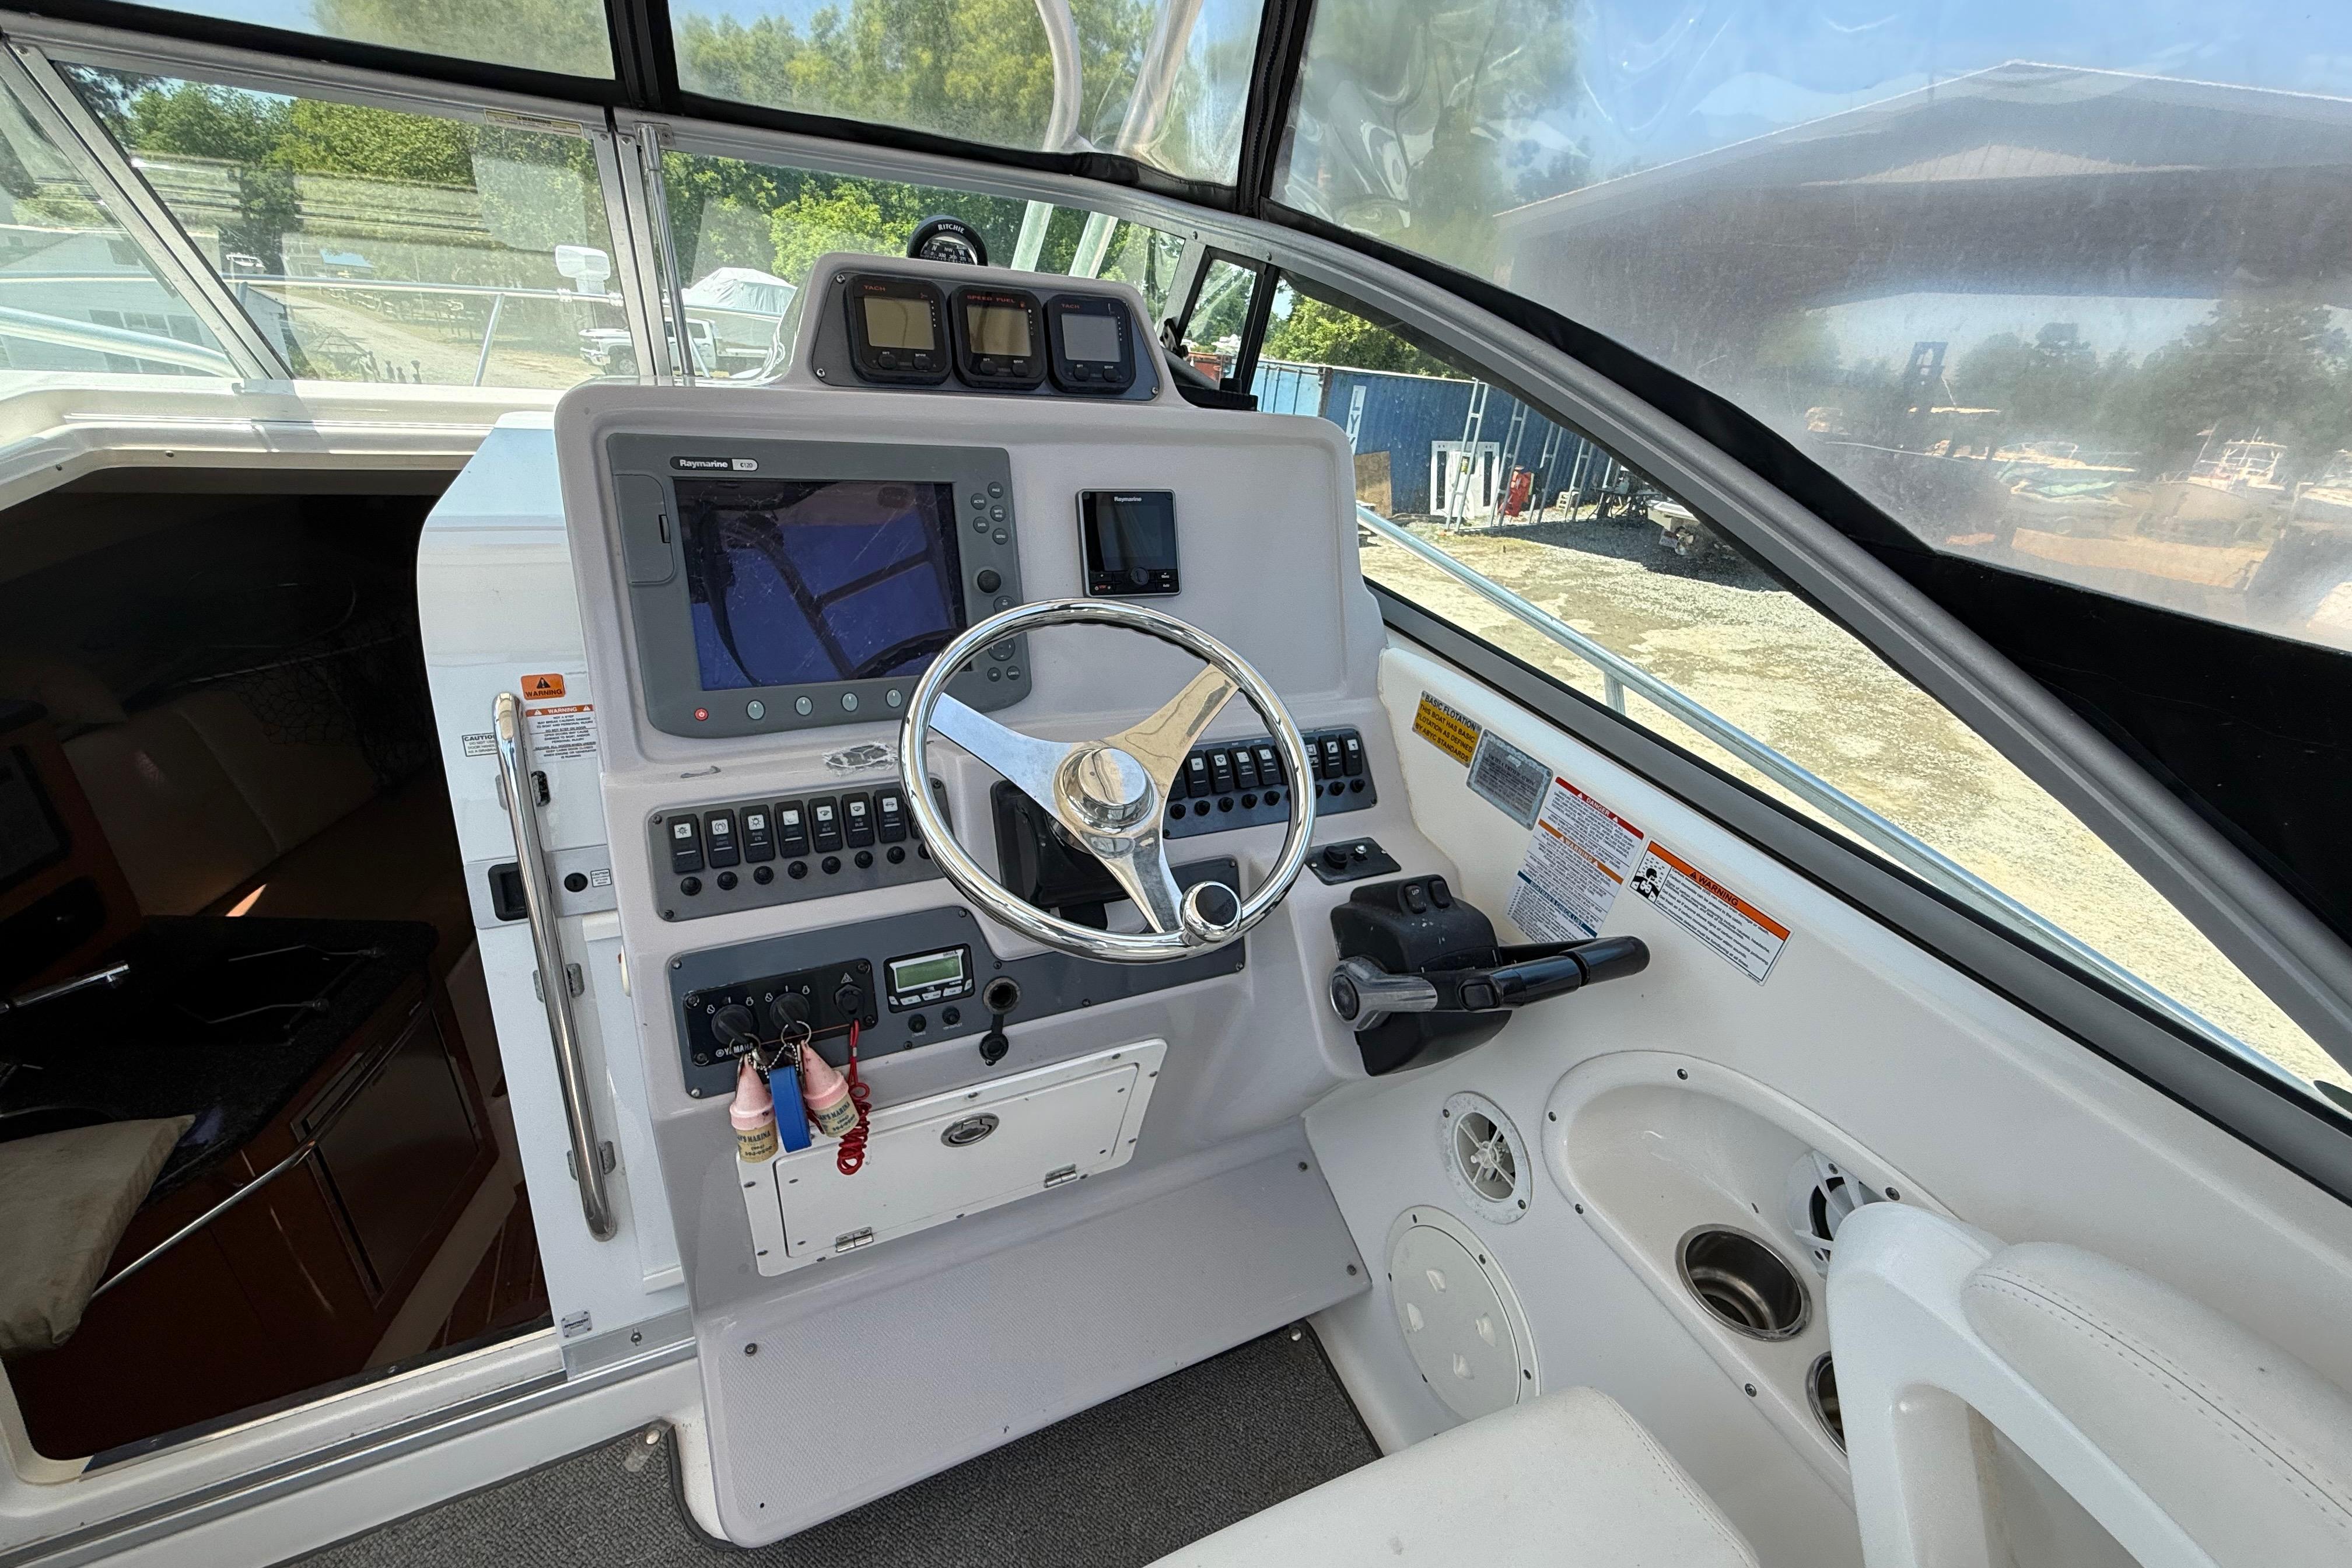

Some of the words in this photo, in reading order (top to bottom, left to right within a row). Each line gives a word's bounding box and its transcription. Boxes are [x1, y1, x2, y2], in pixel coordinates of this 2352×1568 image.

[937, 223, 965, 234] RITCHIE
[679, 459, 729, 468] Raymarine
[525, 689, 562, 697] WARNING
[1419, 703, 1432, 715] THIS
[1431, 710, 1446, 724] BOAT
[1445, 720, 1457, 732] HAS
[1457, 727, 1475, 743] BASIC
[1424, 694, 1443, 710] BASIC
[1443, 705, 1476, 731] FLOTATION
[1415, 722, 1423, 732] BY
[1422, 727, 1437, 741] ABYC
[1436, 736, 1469, 762] STANDARDS
[1416, 712, 1443, 733] FLOTATION
[1442, 729, 1450, 738] AS
[1450, 734, 1473, 753] DEFINED
[1586, 797, 1610, 817] DANGER
[1564, 838, 1594, 863] WARNING
[1697, 875, 1740, 907] WARNING
[1555, 901, 1572, 918] CHECK
[1572, 915, 1583, 927] LIST
[831, 1101, 850, 1118] MARINA
[747, 1130, 771, 1142] MARINA
